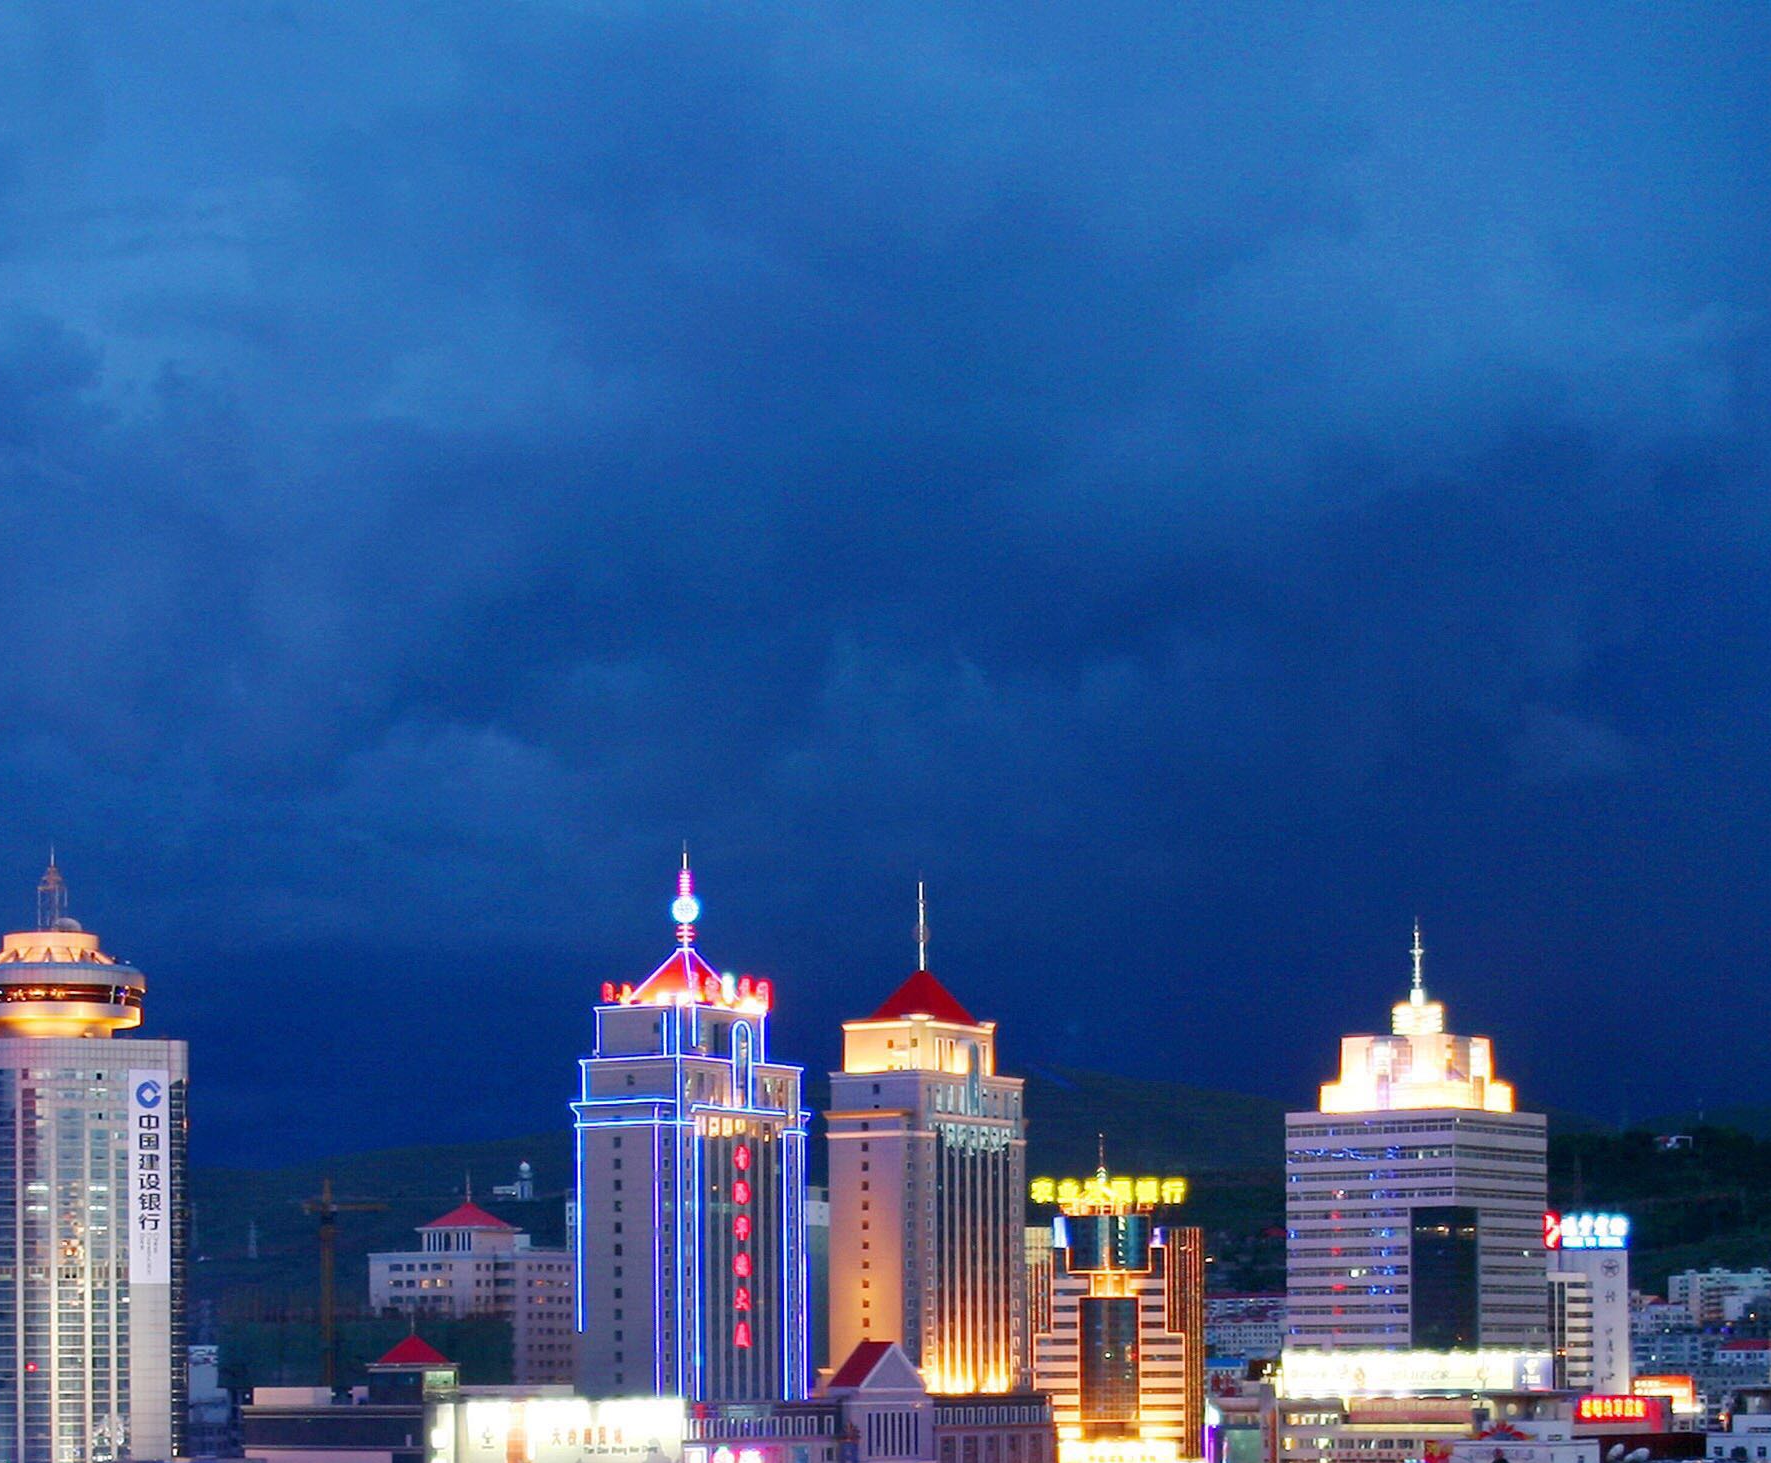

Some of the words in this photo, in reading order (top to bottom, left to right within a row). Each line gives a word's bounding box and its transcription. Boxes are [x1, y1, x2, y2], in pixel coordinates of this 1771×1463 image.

[138, 1114, 161, 1231] 中国建设银行
